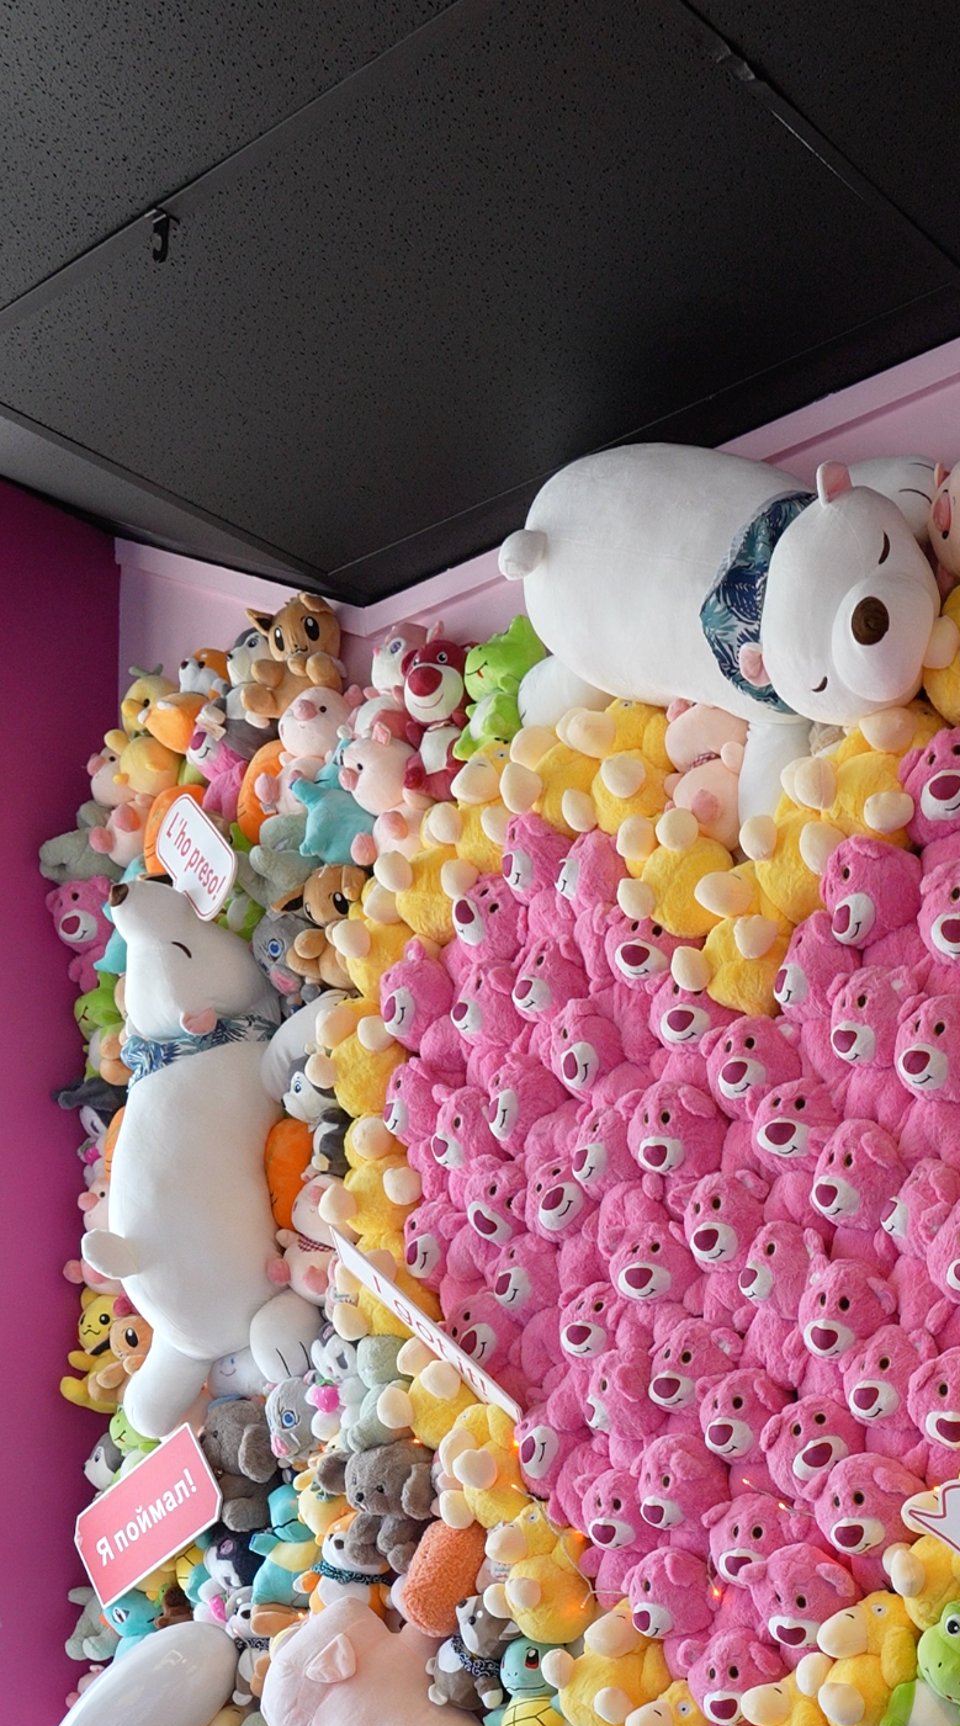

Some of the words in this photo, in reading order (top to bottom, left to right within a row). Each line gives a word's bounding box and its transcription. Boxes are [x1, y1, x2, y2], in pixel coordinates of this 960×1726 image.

[166, 812, 192, 857] L'ho
[184, 847, 226, 901] preso!
[373, 1275, 382, 1294] I
[394, 1299, 447, 1354] got
[456, 1356, 488, 1397] it!
[96, 1536, 115, 1567] Я
[114, 1468, 197, 1552] поймал!
